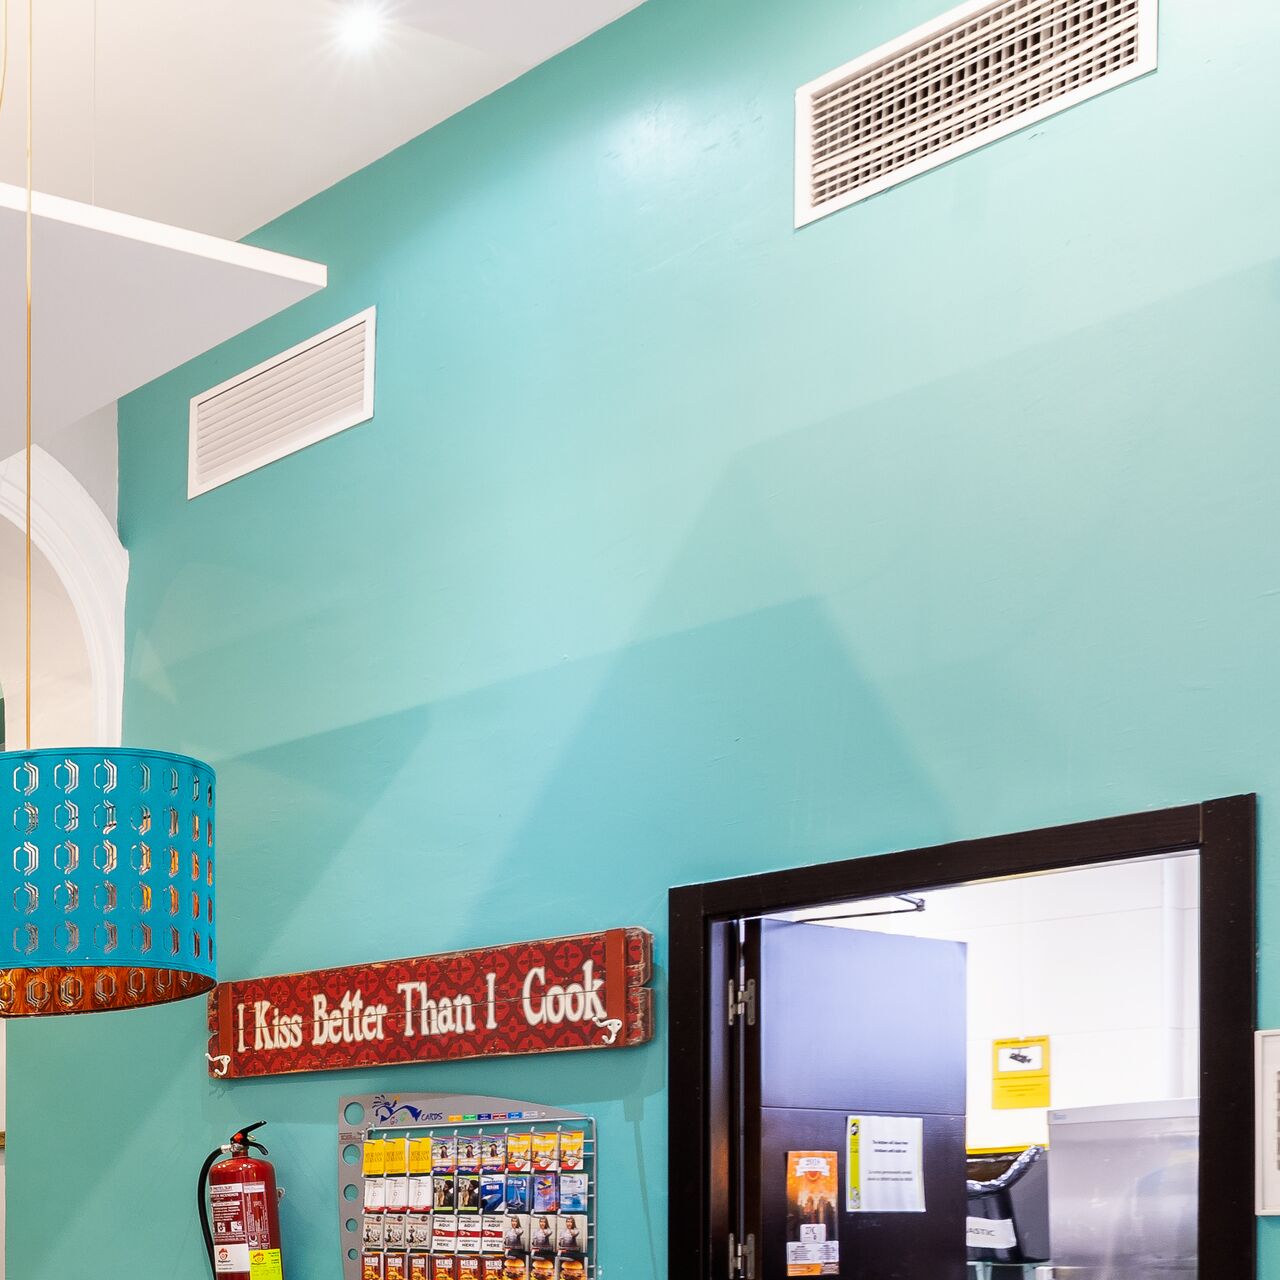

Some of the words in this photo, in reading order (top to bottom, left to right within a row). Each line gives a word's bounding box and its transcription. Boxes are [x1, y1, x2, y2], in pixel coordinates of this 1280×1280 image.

[236, 1003, 246, 1053] I
[252, 1000, 303, 1051] Kiss
[312, 989, 388, 1052] Better
[397, 981, 476, 1038] Than
[485, 973, 498, 1029] I
[521, 959, 608, 1026] Cook
